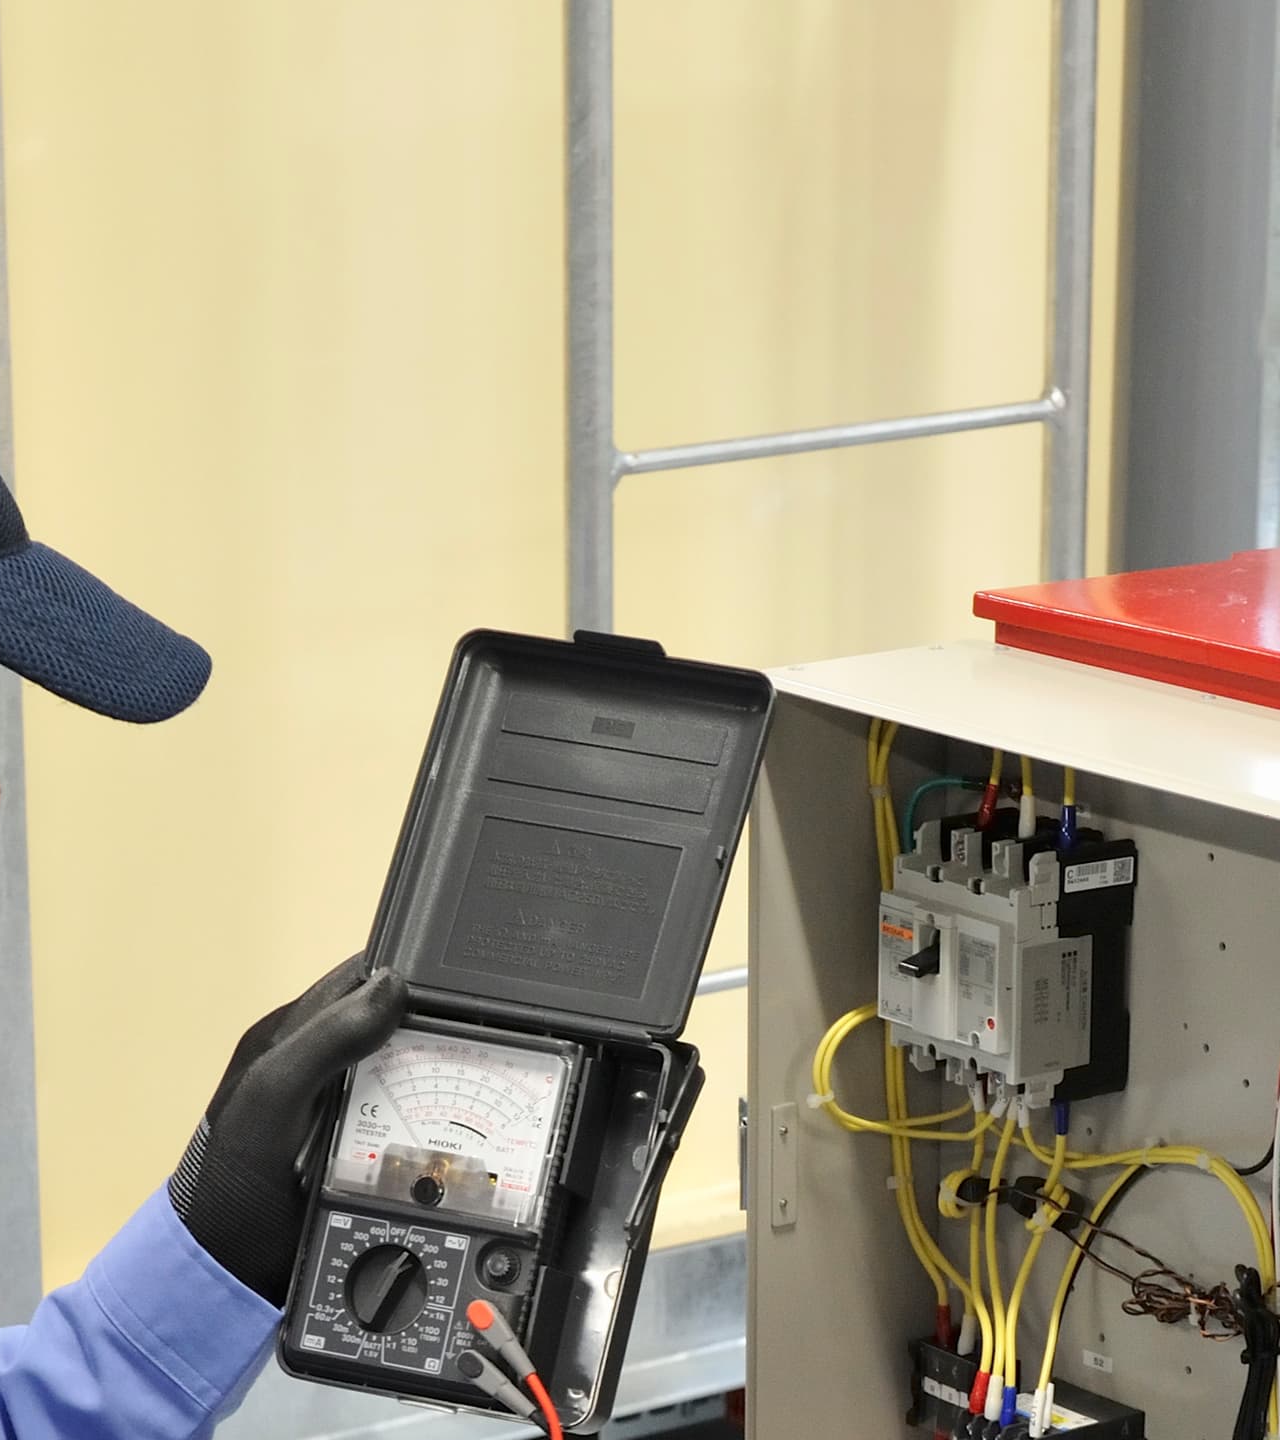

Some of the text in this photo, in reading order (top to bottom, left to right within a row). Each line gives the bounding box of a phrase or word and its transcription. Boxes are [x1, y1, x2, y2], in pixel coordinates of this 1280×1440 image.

[427, 1138, 463, 1151] HIOKI
[391, 1227, 406, 1237] OFF
[330, 1258, 343, 1267] 30
[327, 1275, 337, 1284] 12
[436, 1277, 448, 1287] 30
[435, 1295, 446, 1304] 12
